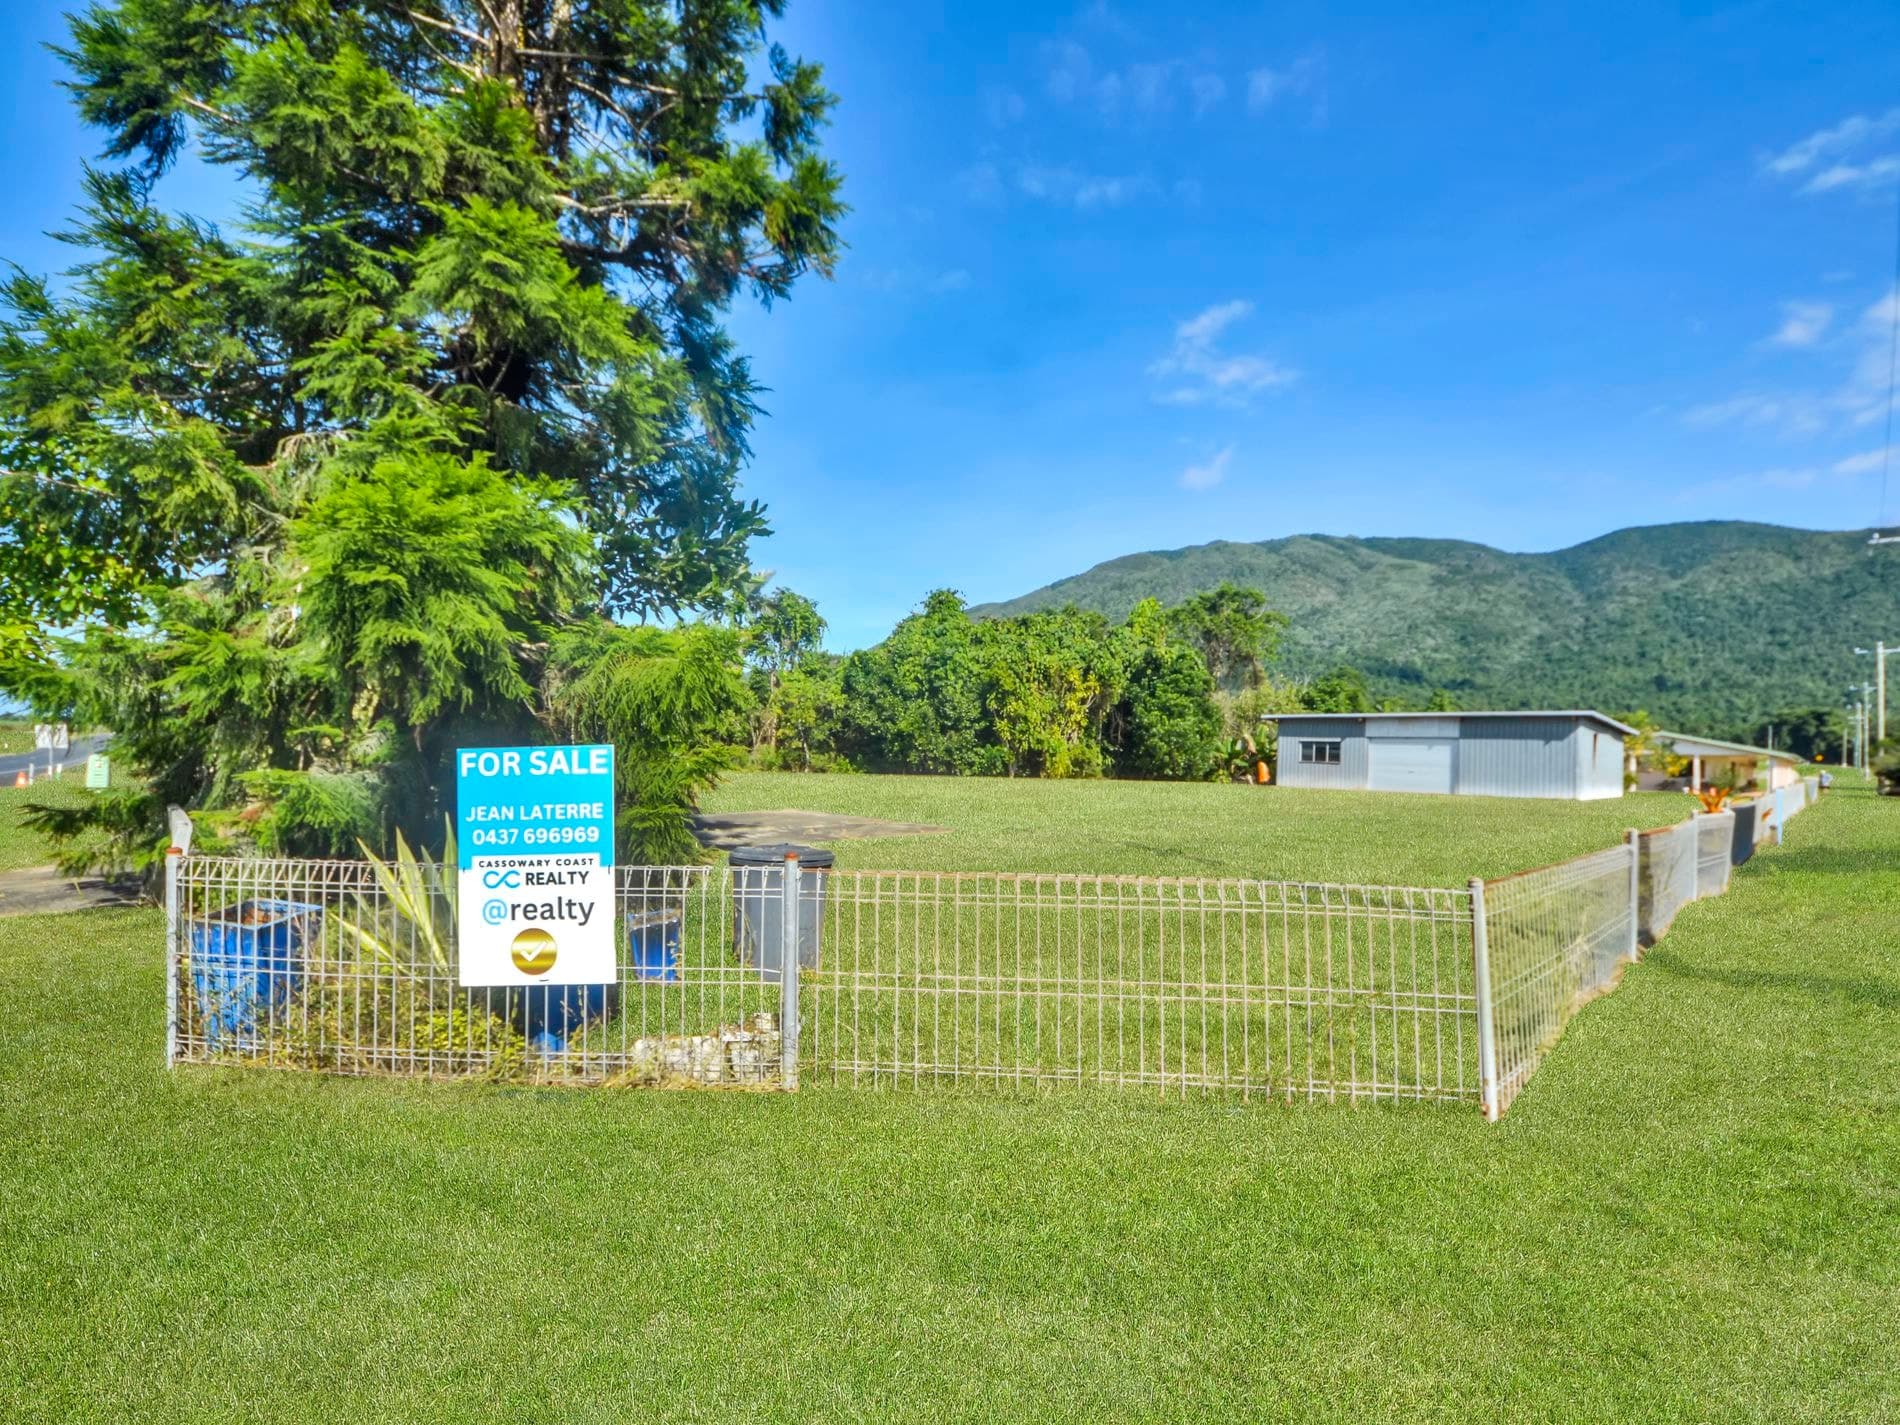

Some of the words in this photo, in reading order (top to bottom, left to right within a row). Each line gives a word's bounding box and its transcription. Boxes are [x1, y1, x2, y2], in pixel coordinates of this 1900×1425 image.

[460, 751, 521, 777] FOR
[529, 749, 609, 775] SALE
[465, 805, 514, 822] JEAN
[520, 802, 604, 820] LATERRE
[472, 828, 519, 845] 0437
[523, 826, 600, 844] 696969
[478, 859, 551, 868] CASSOWARY
[555, 858, 594, 866] COAST
[525, 871, 589, 886] REALTY
[482, 896, 595, 926] @realty
